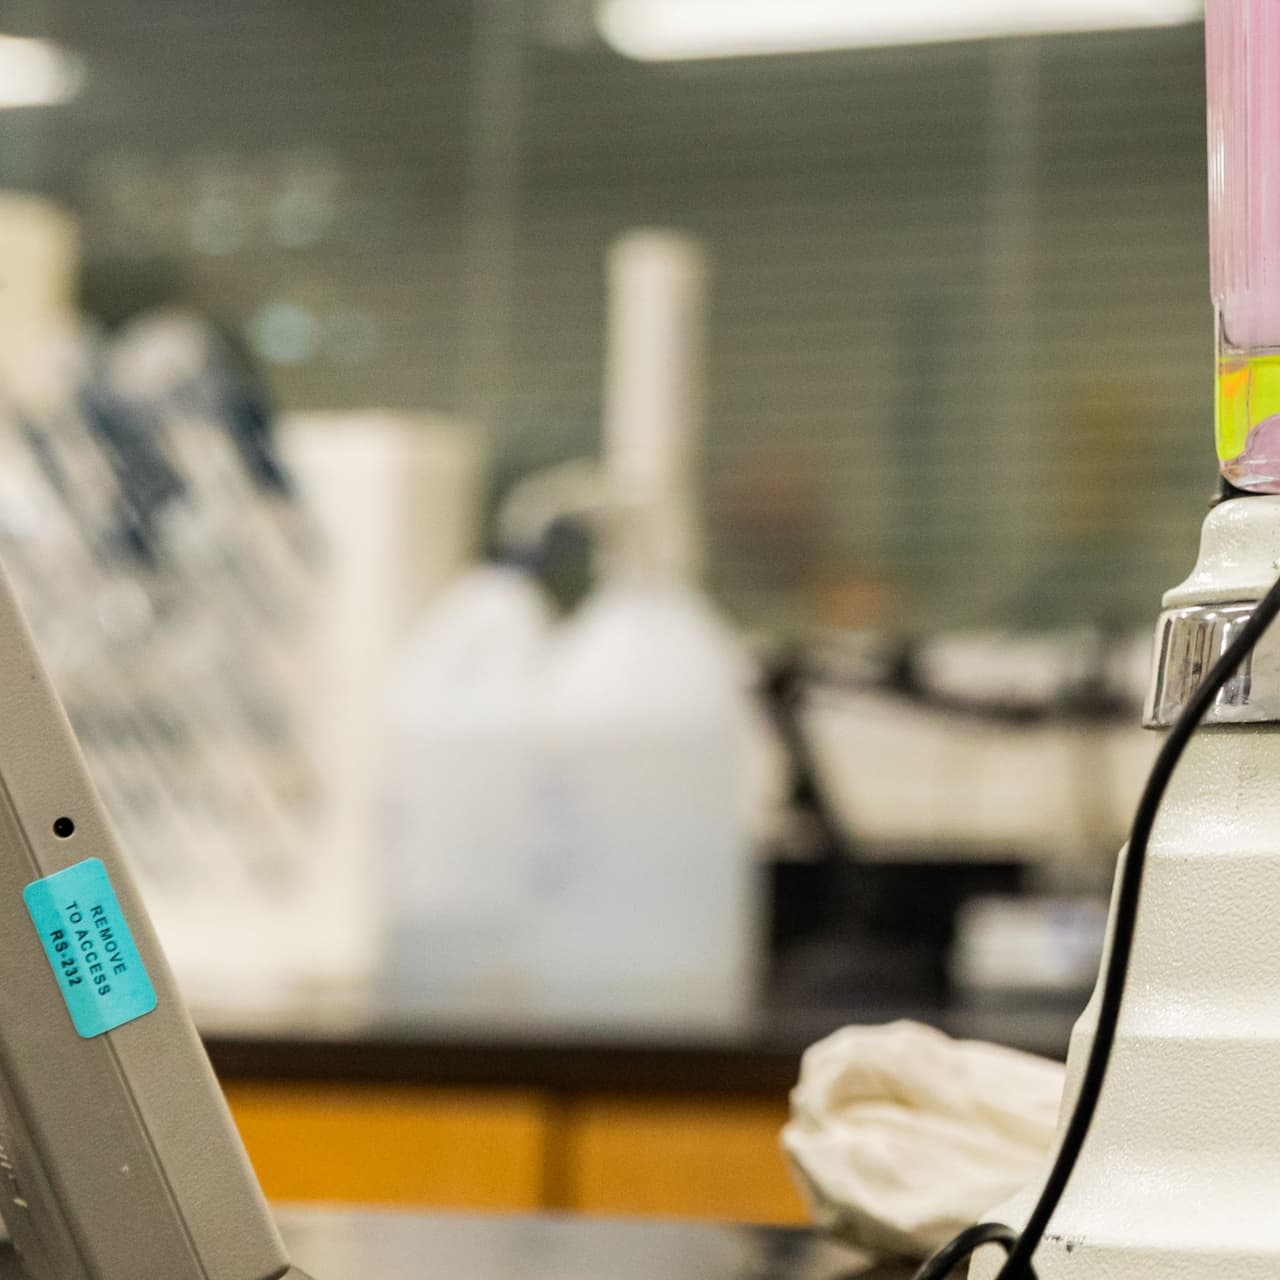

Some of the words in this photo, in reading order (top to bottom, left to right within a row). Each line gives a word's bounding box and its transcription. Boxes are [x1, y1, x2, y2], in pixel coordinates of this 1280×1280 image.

[49, 928, 83, 988] RS-232
[65, 900, 83, 925] TO
[74, 929, 112, 996] ACCESS
[89, 904, 127, 976] REMOVE
